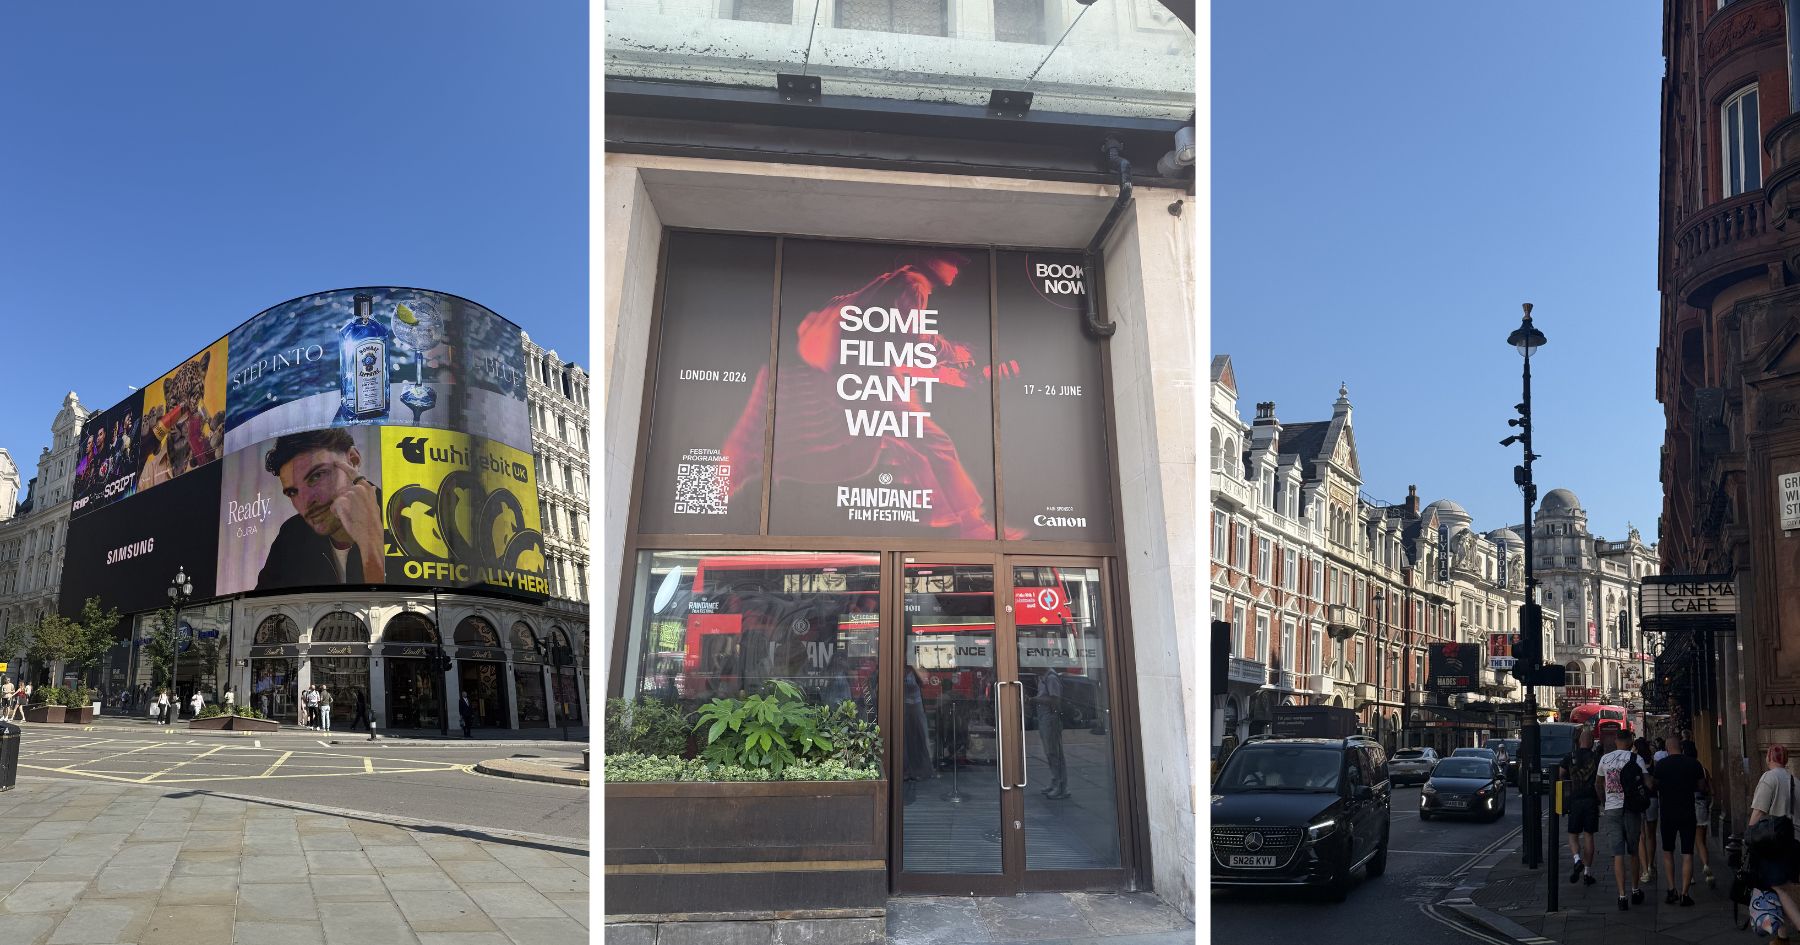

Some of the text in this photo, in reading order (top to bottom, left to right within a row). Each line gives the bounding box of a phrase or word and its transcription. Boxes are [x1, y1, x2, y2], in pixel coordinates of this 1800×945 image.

[1036, 263, 1084, 278] BOOK
[1044, 280, 1085, 295] NOW
[839, 305, 939, 335] SOME
[840, 339, 938, 369] FILMS
[232, 344, 323, 391] STEP INTO
[680, 369, 747, 383] LONDON 2026
[836, 373, 940, 403] CAN'T
[1024, 384, 1035, 395] 17
[1045, 385, 1056, 396] 26
[1059, 385, 1082, 396] JUNE
[844, 409, 931, 439] WAIT
[690, 448, 720, 456] FESTIVAL
[429, 445, 512, 478] whiebit
[514, 467, 528, 480] UK
[1784, 476, 1800, 489] GR
[73, 496, 90, 511] RIP
[104, 472, 136, 498] SCRIPT
[836, 485, 933, 509] RAINDANCE
[228, 492, 272, 524] Ready.
[848, 508, 920, 522] FILM FESTIVAL
[1786, 503, 1800, 515] ST
[1033, 514, 1087, 528] Canon
[106, 537, 155, 565] SAMSUNG
[1439, 534, 1448, 578] LYRIC
[1498, 546, 1506, 587] APOLLO
[1664, 582, 1735, 596] CINEMA
[688, 601, 720, 610] RAINDANCE
[1671, 598, 1718, 612] CAFE
[1491, 659, 1503, 668] THE
[1436, 677, 1470, 687] HADES
[1232, 856, 1254, 865] SN26
